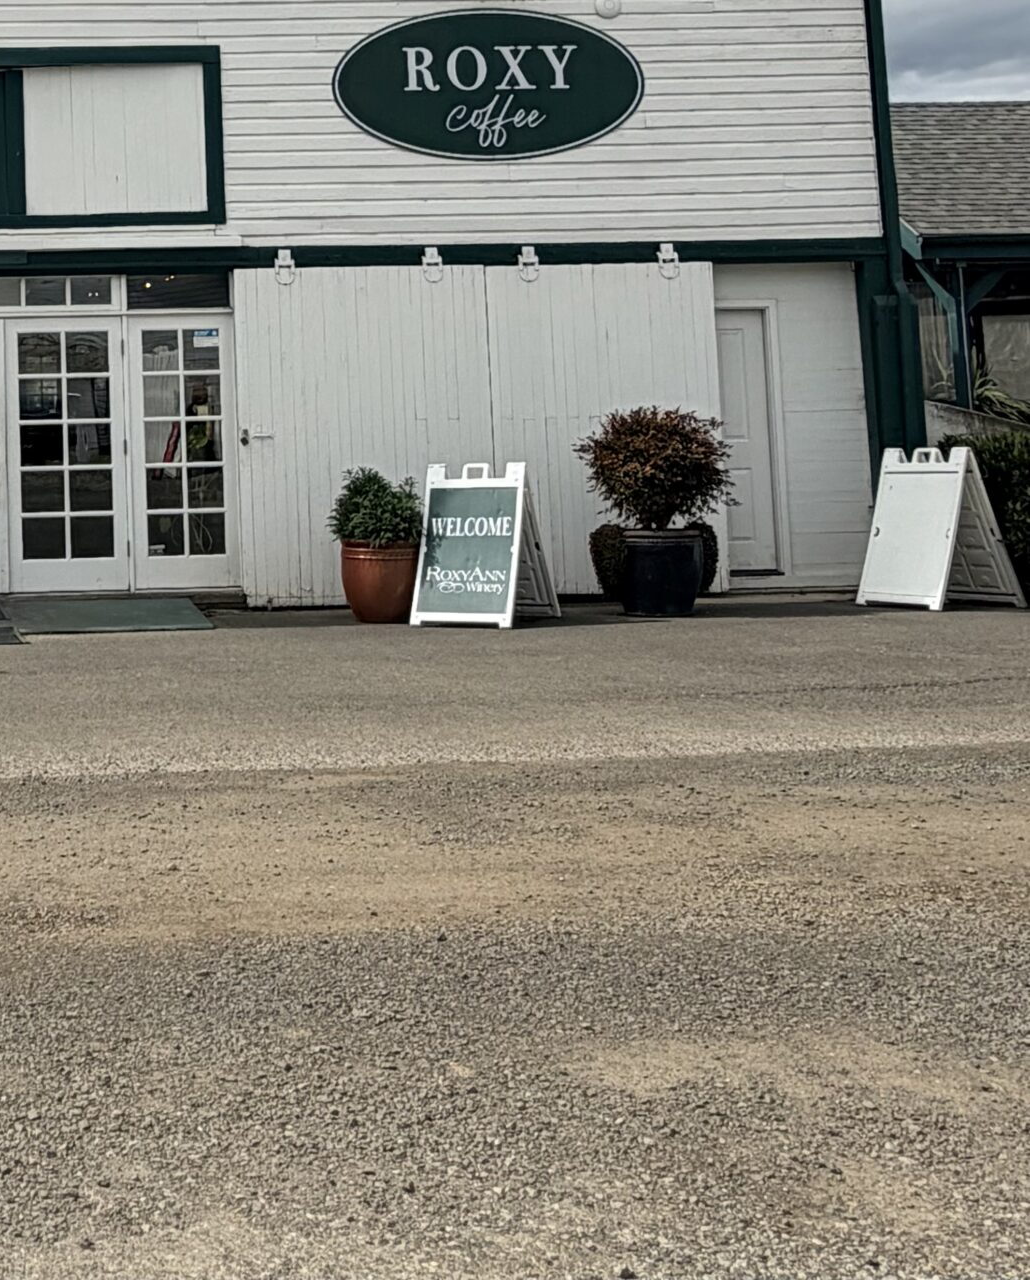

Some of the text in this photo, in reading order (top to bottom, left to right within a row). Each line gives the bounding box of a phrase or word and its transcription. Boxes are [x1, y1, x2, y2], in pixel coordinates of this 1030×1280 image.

[402, 45, 577, 91] ROXY
[431, 516, 512, 537] WELCOME
[466, 582, 505, 595] Winery
